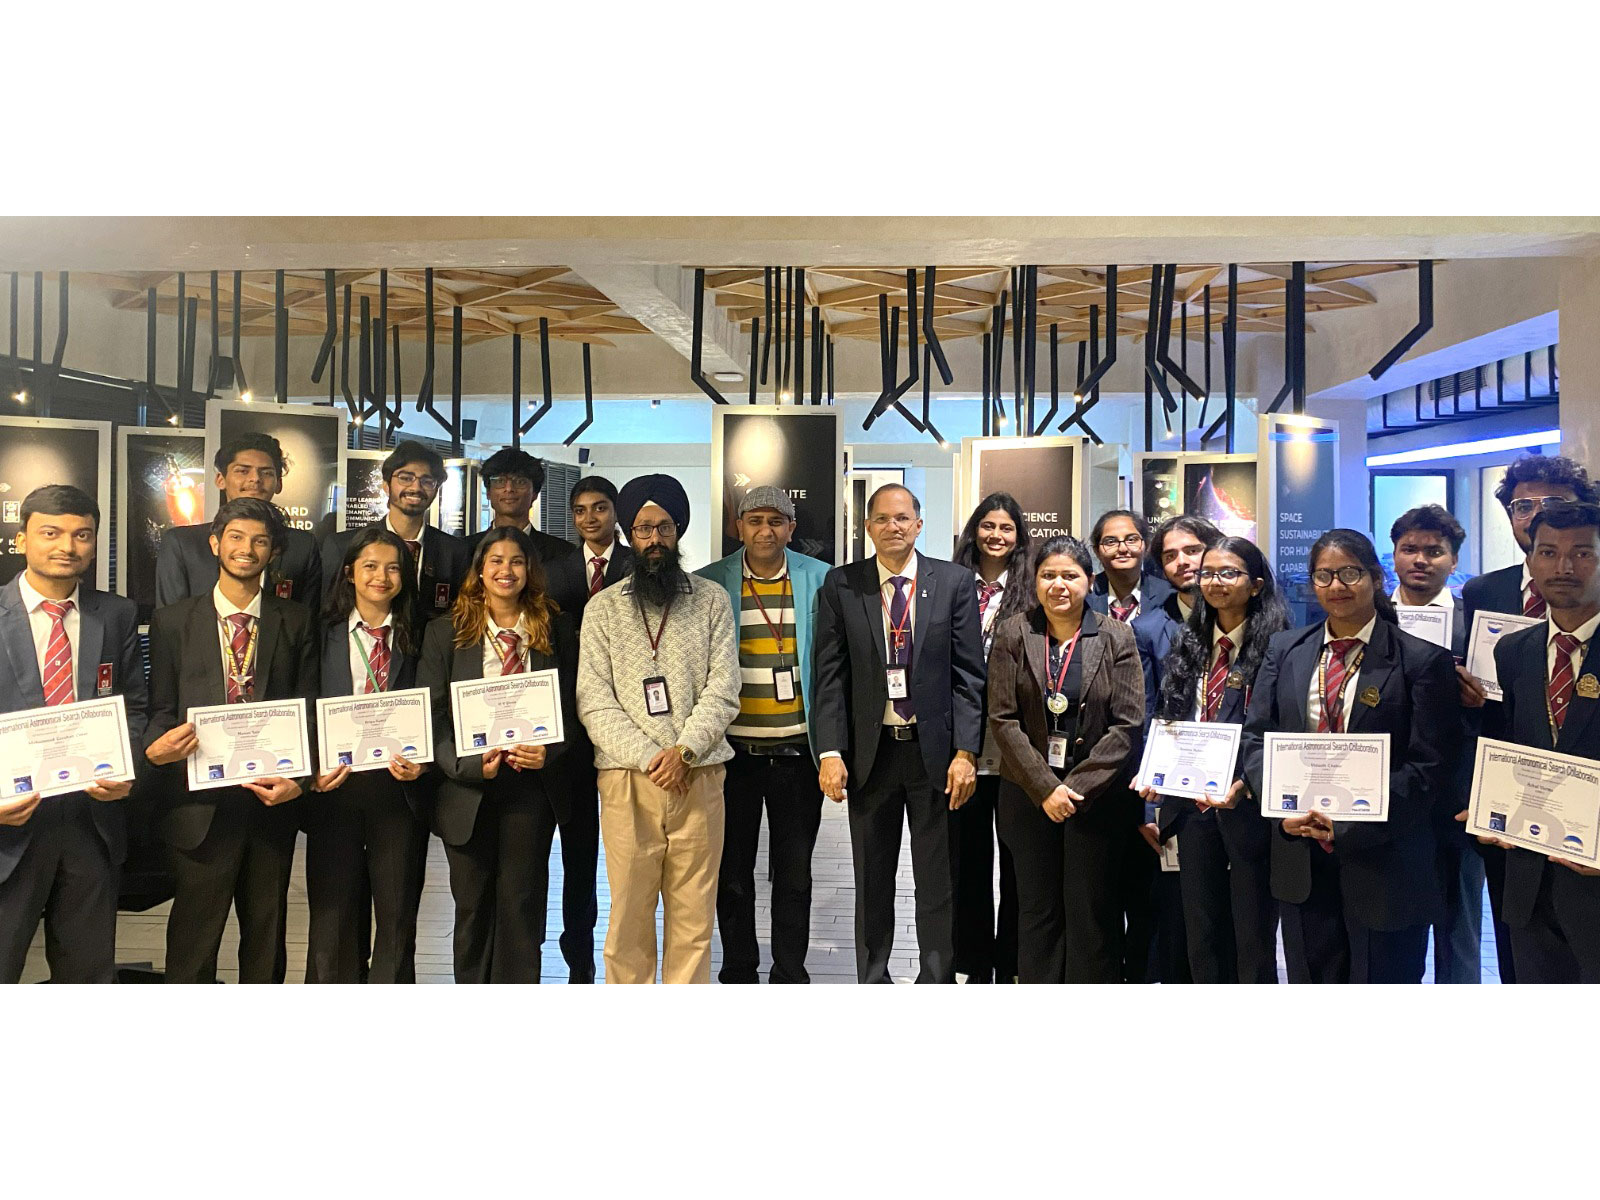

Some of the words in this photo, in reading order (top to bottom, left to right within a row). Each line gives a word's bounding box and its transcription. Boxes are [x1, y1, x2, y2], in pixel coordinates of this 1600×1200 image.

[1022, 513, 1057, 522] CIENCE
[1279, 513, 1302, 522] SPACE
[1028, 529, 1067, 537] CATION
[1280, 547, 1294, 555] FOR
[1280, 564, 1308, 572] CAPABIL
[462, 686, 485, 698] International
[486, 684, 509, 693] Astronomical
[511, 681, 524, 689] Search
[524, 680, 549, 688] Collaboration
[329, 703, 353, 715] International
[354, 701, 379, 711] Astronomical
[380, 699, 395, 708] Search
[395, 697, 421, 706] Collaboration
[200, 714, 226, 726] International
[226, 711, 252, 721] Astronomical
[254, 710, 268, 718] Search
[269, 708, 295, 717] Collaboration
[1277, 742, 1303, 752] International
[1303, 741, 1331, 751] Astronomical
[1332, 741, 1348, 751] Search
[1349, 742, 1378, 754] Collaboration
[1489, 752, 1517, 764] International
[1518, 755, 1548, 769] Astronomical
[1549, 761, 1565, 774] Search
[1566, 765, 1599, 786] Collaboration
